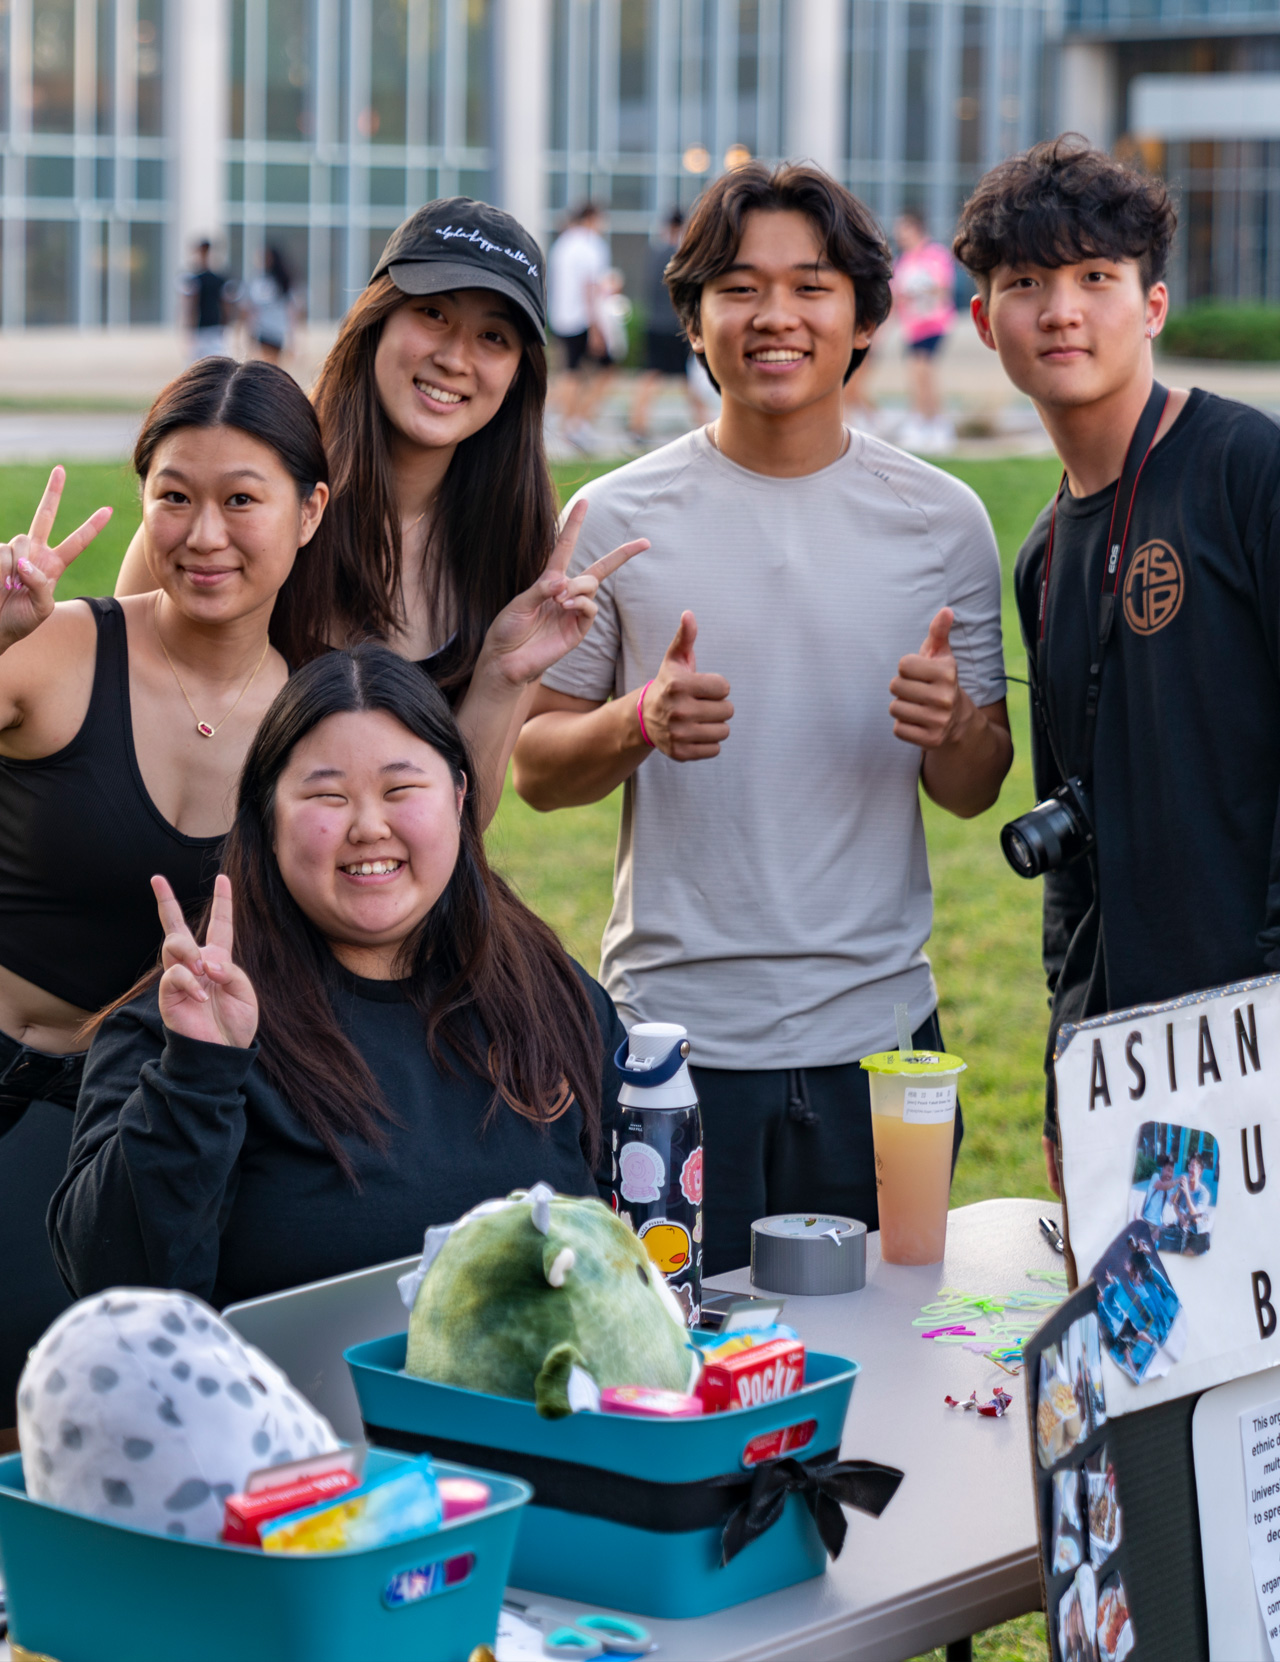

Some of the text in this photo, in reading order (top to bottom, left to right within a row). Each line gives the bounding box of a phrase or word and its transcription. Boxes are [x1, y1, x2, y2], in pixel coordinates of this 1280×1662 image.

[1108, 544, 1120, 574] EOS
[1089, 1003, 1261, 1112] ASIAN
[1241, 1124, 1266, 1194] U
[1251, 1270, 1278, 1340] B
[1253, 1416, 1268, 1433] This
[1252, 1437, 1275, 1457] ethnic
[1254, 1512, 1263, 1525] to
[1269, 1626, 1278, 1639] we
